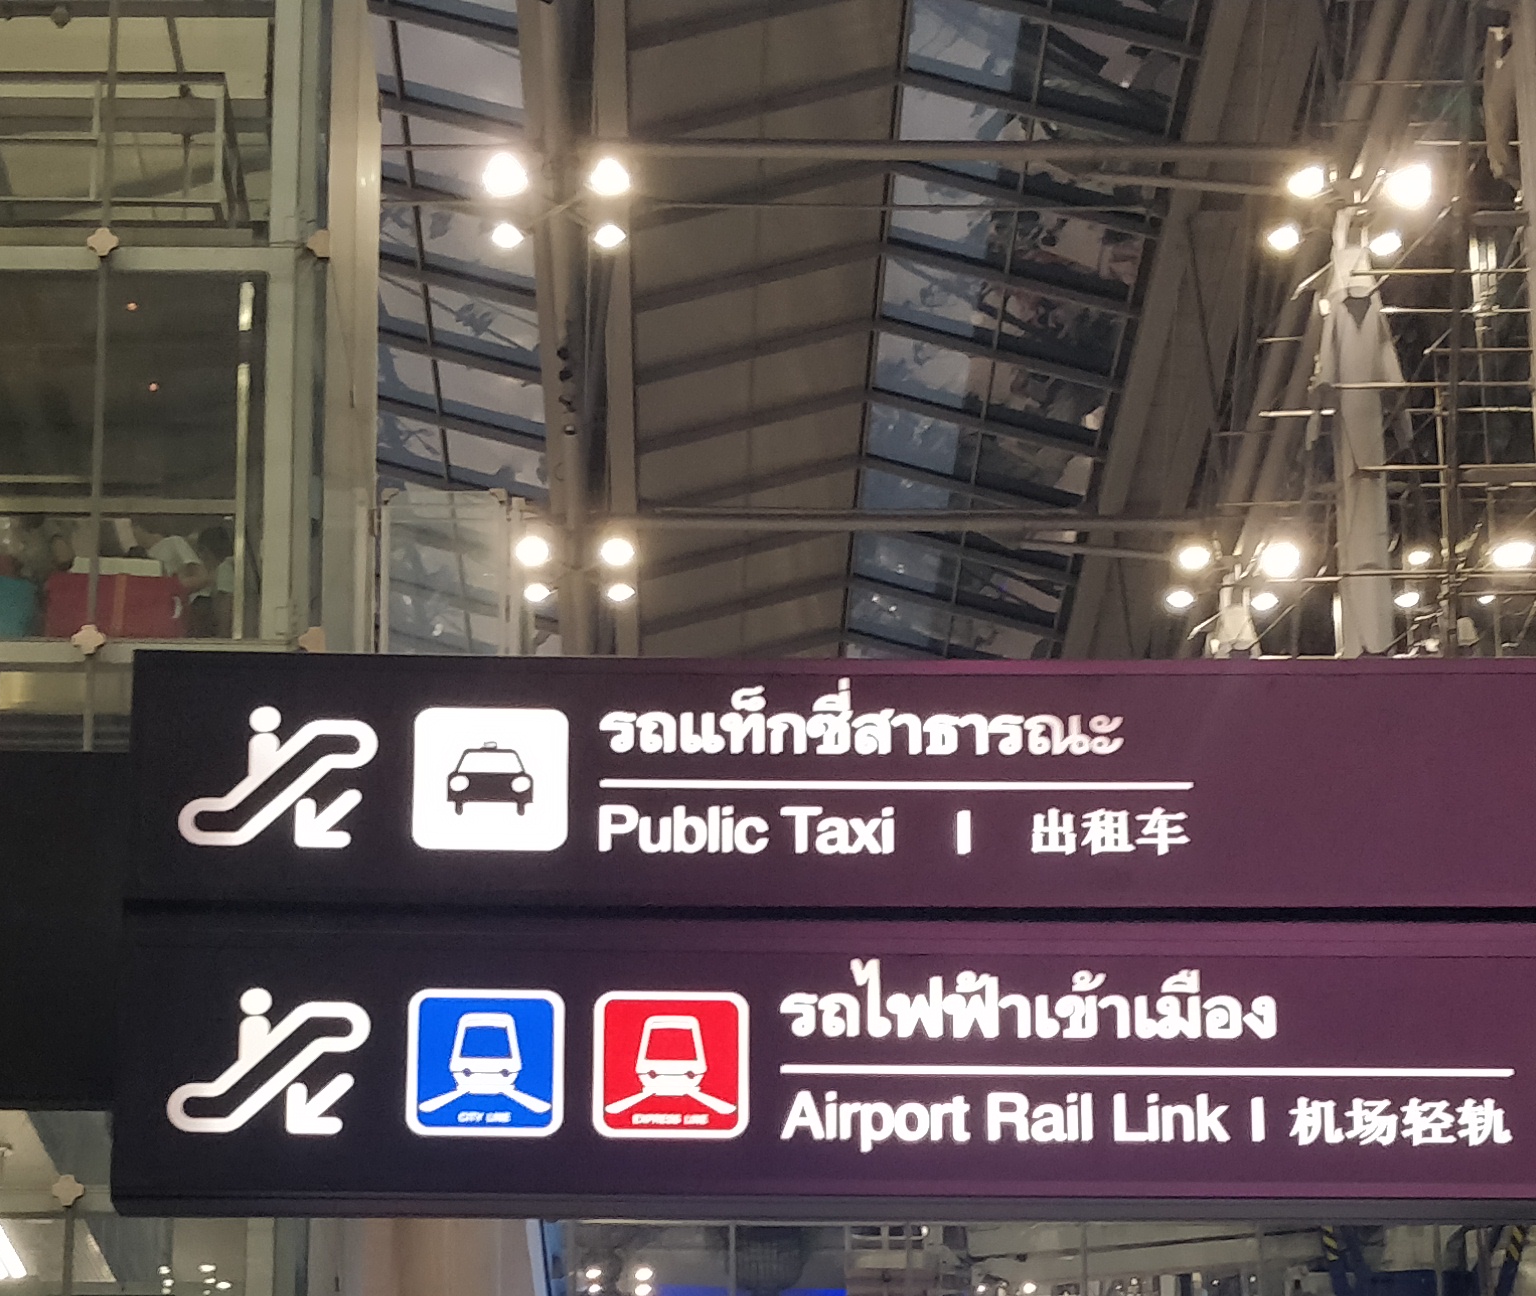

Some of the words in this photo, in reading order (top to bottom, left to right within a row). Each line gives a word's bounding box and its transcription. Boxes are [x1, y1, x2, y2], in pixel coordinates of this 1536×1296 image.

[598, 678, 1124, 757] รถแท็กซี่สาธารณะ
[599, 806, 769, 855] Public
[789, 806, 895, 854] Taxi
[1031, 806, 1192, 856] 出租车
[779, 958, 1277, 1040] รถไฟฟ้าเข้าเมือง
[780, 1091, 970, 1153] Airport
[986, 1092, 1092, 1142] Rail
[1113, 1092, 1230, 1142] Link
[1288, 1096, 1513, 1148] 机场轻轨
